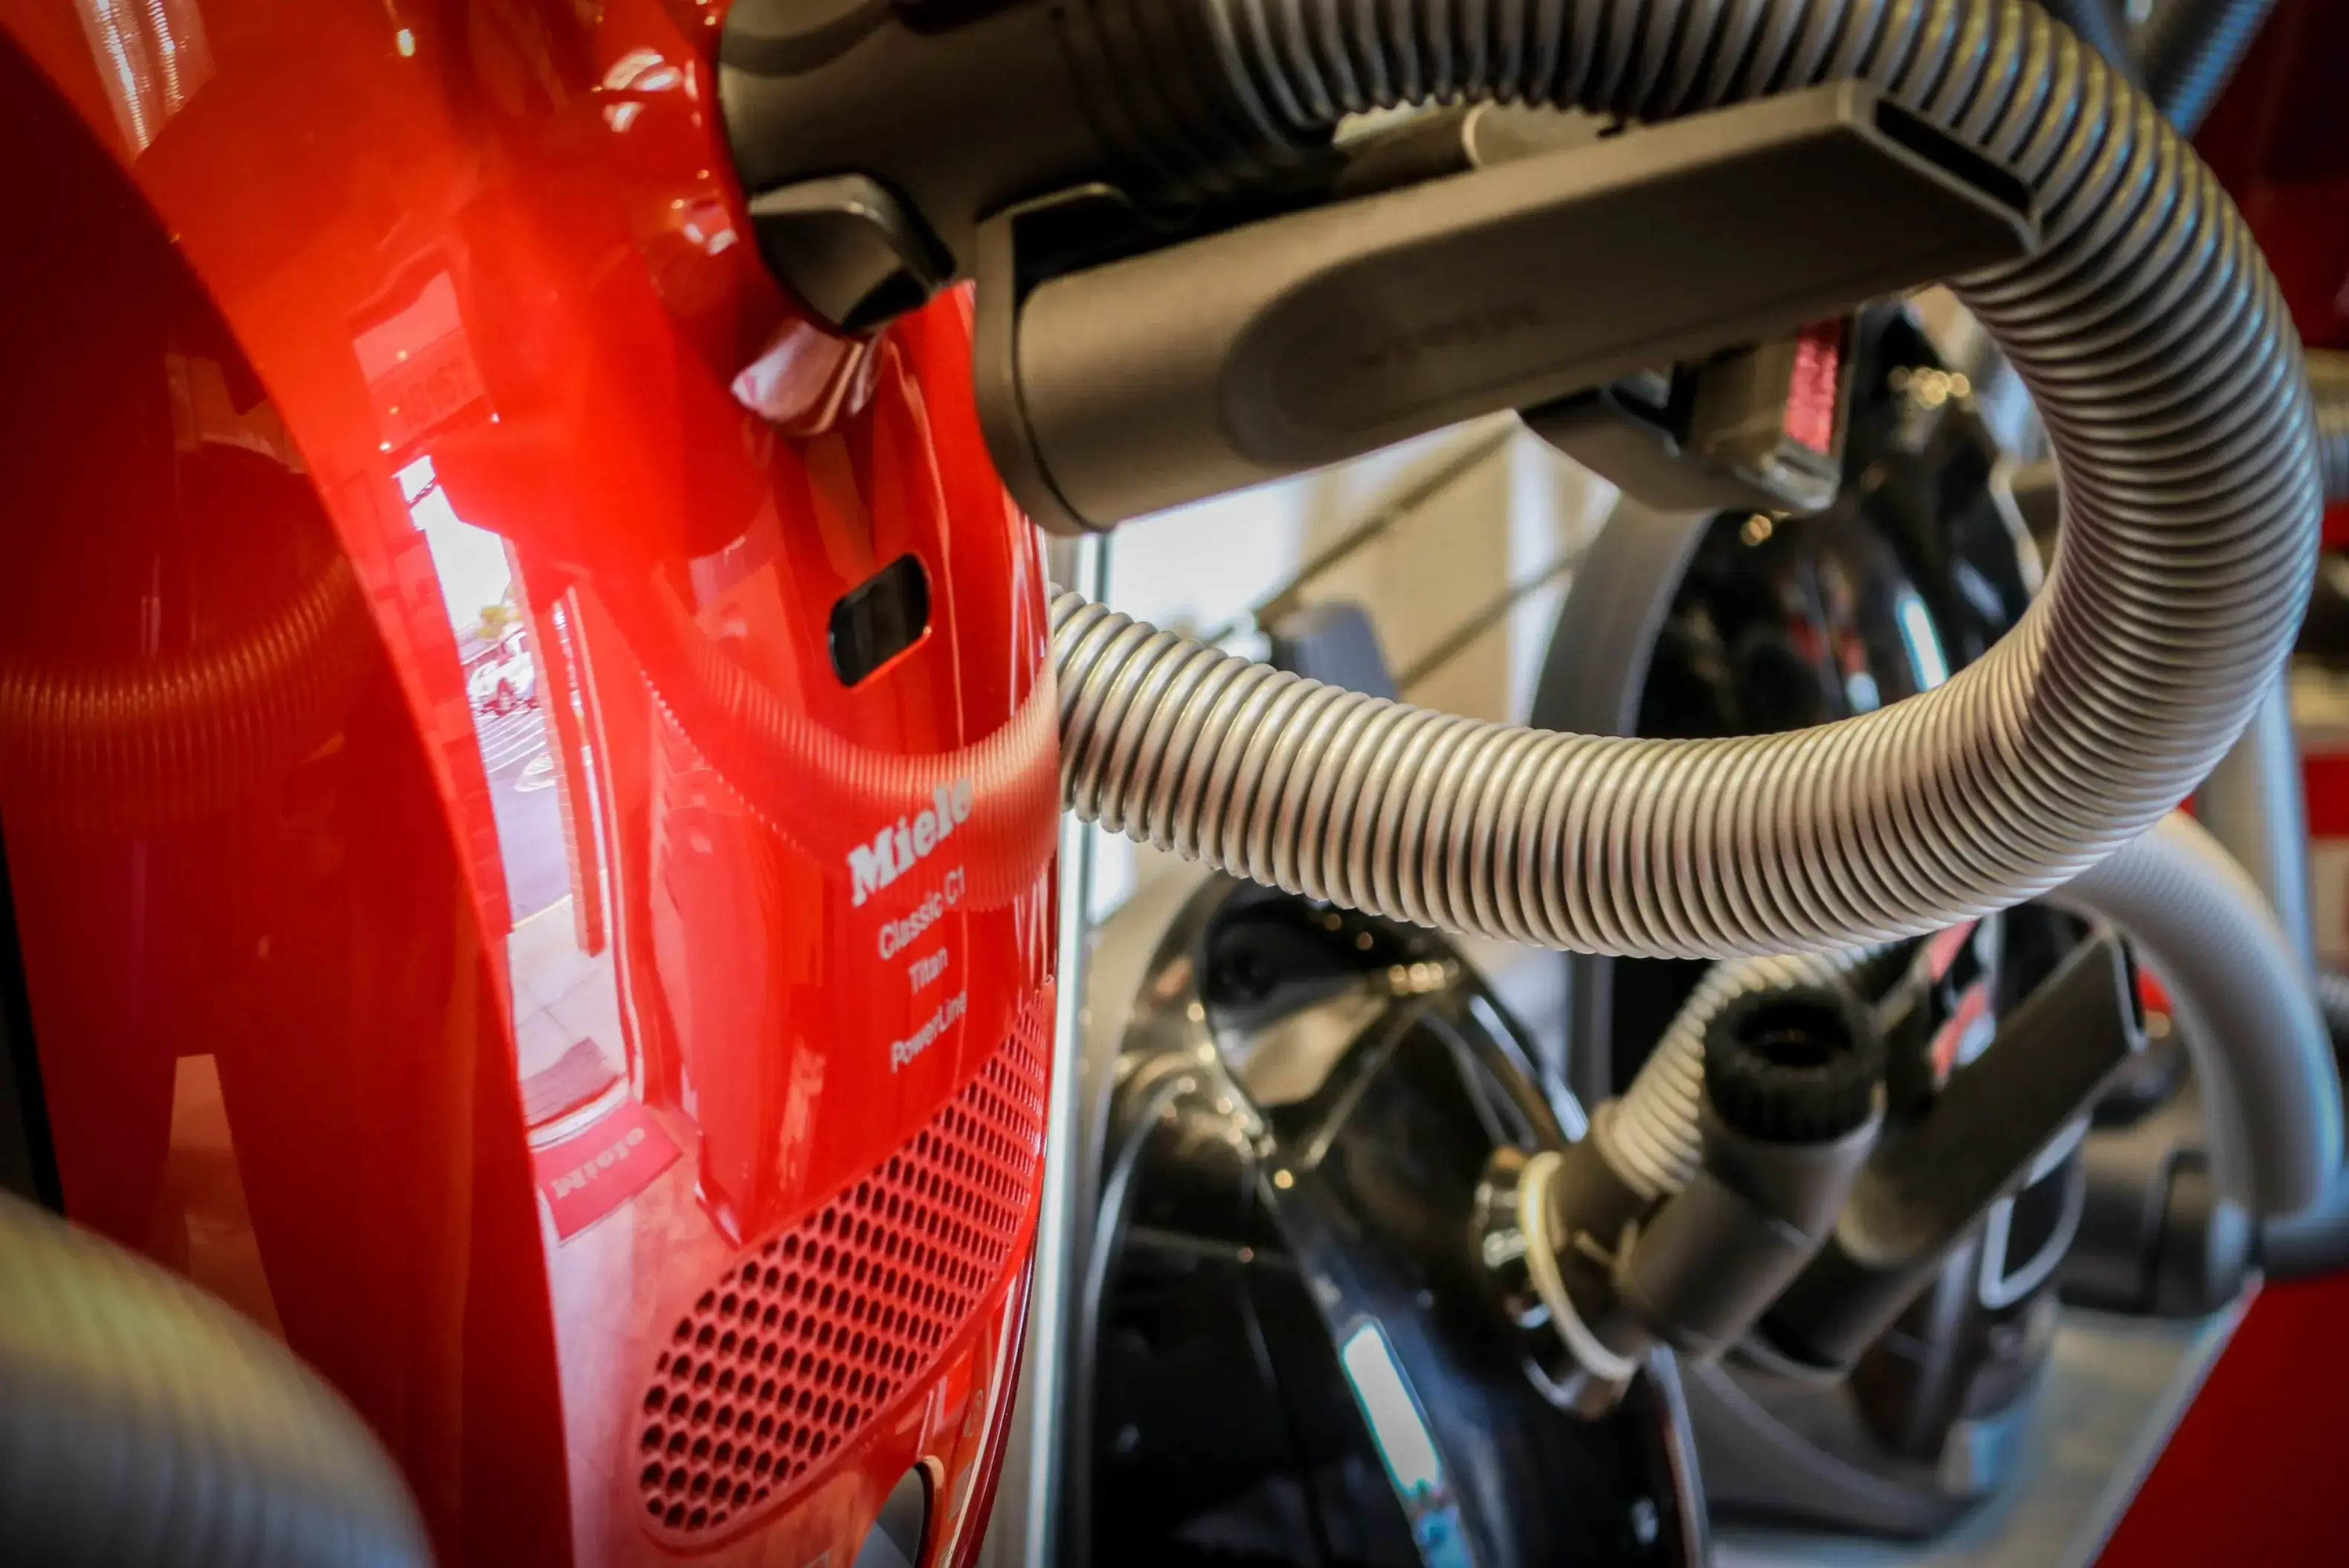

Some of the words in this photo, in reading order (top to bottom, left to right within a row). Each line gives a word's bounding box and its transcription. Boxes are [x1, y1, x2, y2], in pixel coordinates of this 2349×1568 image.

[847, 778, 972, 907] Miele
[878, 891, 943, 960] Classic
[944, 863, 965, 906] C1
[907, 946, 948, 995] Titan
[889, 990, 966, 1074] PowerLine
